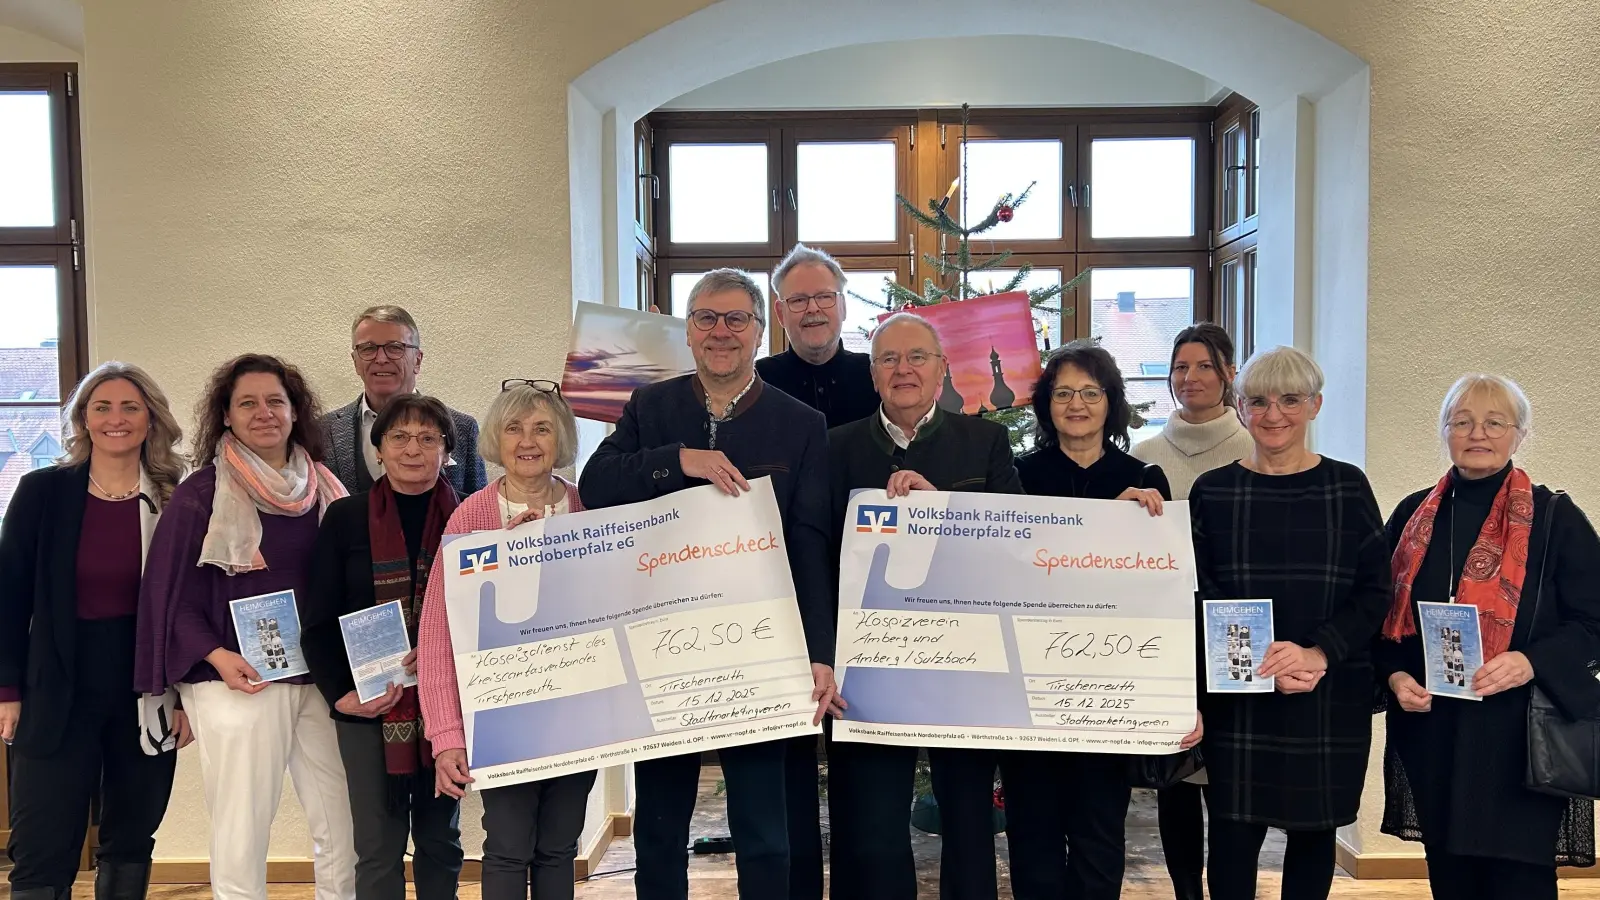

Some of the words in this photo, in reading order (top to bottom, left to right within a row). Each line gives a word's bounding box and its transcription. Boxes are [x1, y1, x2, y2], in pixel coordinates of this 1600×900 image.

[907, 507, 982, 522] Volksbank
[984, 510, 1083, 526] Raiffeisenbank
[506, 530, 580, 552] Volksbank
[582, 508, 680, 540] Raiffeisenbank
[907, 523, 1011, 539] Nordoberpfalz
[1014, 528, 1032, 540] eG
[508, 540, 613, 567] Nordoberpfalz
[616, 536, 634, 549] eG
[636, 531, 779, 577] Spendenscheck
[1032, 548, 1179, 575] Spendenscheck
[239, 597, 287, 612] HEIMGEHEN
[904, 596, 915, 604] Wir
[916, 597, 938, 605] freuen
[953, 598, 972, 606] Ihnen
[973, 599, 992, 607] heute
[992, 599, 1022, 609] folgende
[1022, 600, 1047, 610] Spende
[1048, 602, 1086, 610] überreichen
[1094, 602, 1118, 610] dürfen:
[1212, 605, 1264, 614] HEIMGEHEN
[347, 608, 393, 627] HEIMGEHEN
[519, 628, 532, 636] Wir
[532, 624, 554, 634] freuen
[555, 623, 569, 631] uns,
[569, 619, 587, 628] Ihnen
[588, 616, 606, 625] heute
[606, 610, 632, 621] folgende
[632, 604, 653, 616] Spende
[653, 597, 690, 609] überreichen
[700, 592, 724, 601] dürfen:
[856, 610, 960, 631] Hospizverein
[1426, 608, 1471, 618] HEIMGEHEN
[586, 634, 607, 649] des
[652, 622, 743, 659] 762,50
[750, 617, 775, 640] €
[853, 632, 909, 648] Amberg
[913, 634, 945, 644] und
[1045, 631, 1133, 660] 762,50
[1136, 636, 1162, 659] €
[846, 651, 900, 666] Amberg
[913, 651, 977, 665] Sulzbach
[725, 686, 760, 703] 2025
[1099, 697, 1136, 709] 2025
[848, 727, 877, 736] Volksbank
[876, 730, 917, 738] Raiffeisenbank
[917, 732, 957, 740] Nordoberpfalz
[1085, 738, 1131, 746] www.vr-nopf.de
[487, 770, 516, 780] Volksbank
[516, 764, 553, 775] Raiffeisenbank
[553, 757, 588, 768] Nordoberpfalz
[600, 748, 631, 759] Wörthstraße
[710, 728, 757, 740] www.vr-nopf.de
[762, 721, 807, 732] info@vr-nopf.de
